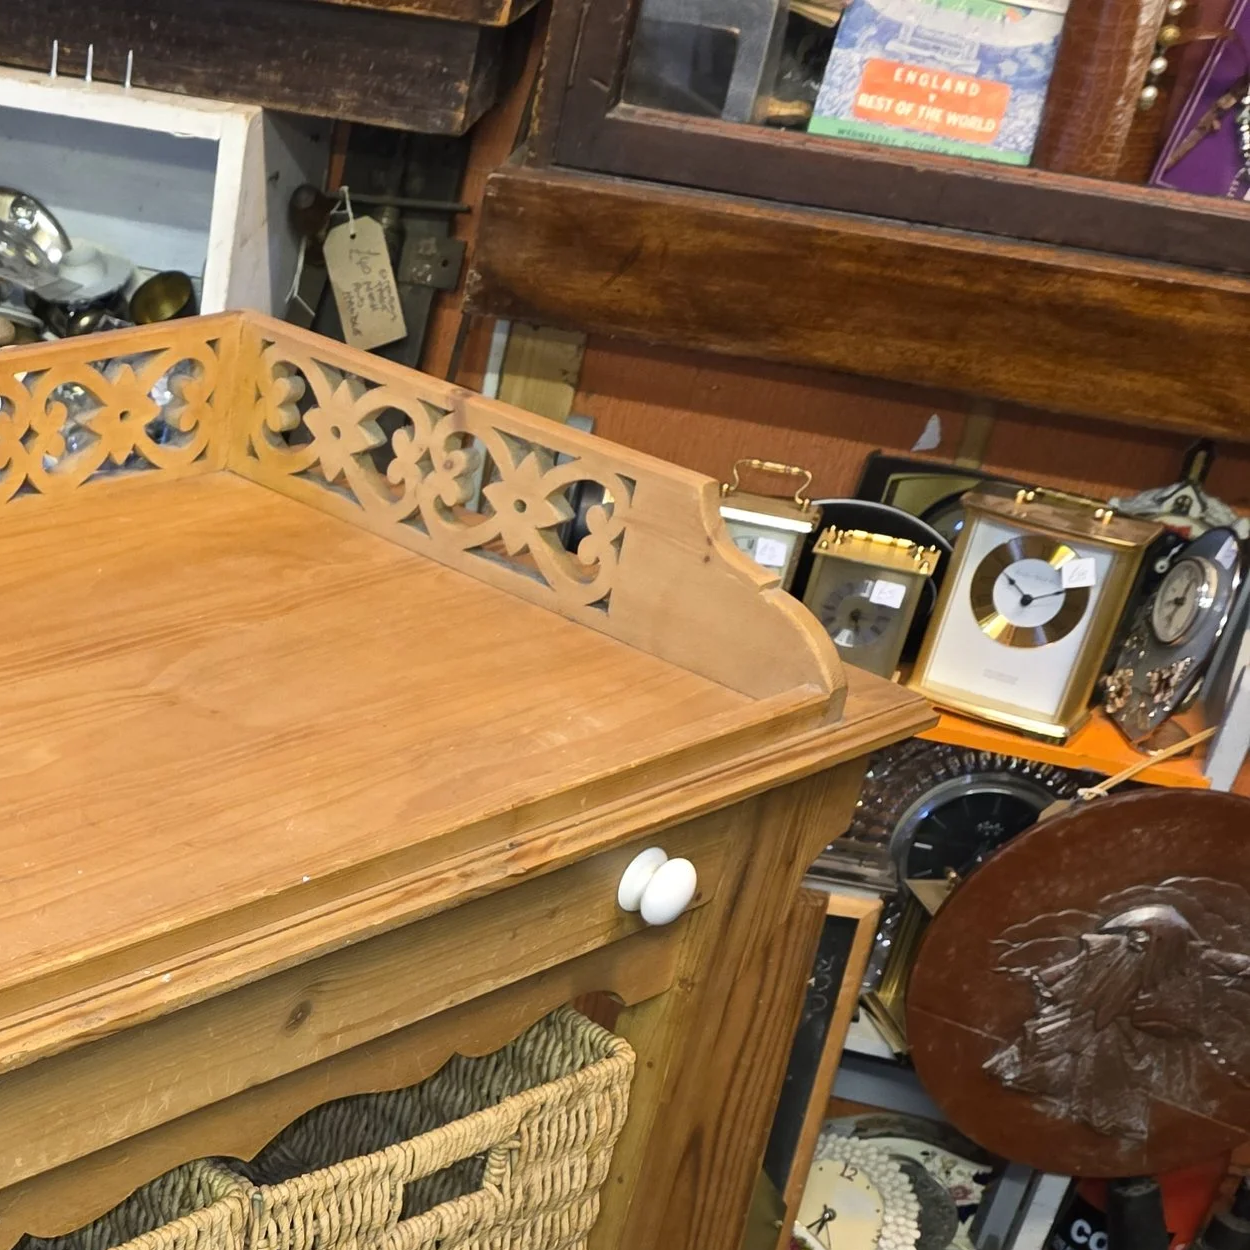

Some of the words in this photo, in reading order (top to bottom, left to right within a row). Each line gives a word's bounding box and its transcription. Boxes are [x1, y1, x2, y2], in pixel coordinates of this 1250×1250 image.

[893, 67, 981, 97] ENGLAND
[857, 92, 892, 112] REST
[894, 98, 916, 116] OF
[917, 104, 943, 125] THE
[945, 110, 997, 133] WORLD
[840, 1158, 859, 1182] 12
